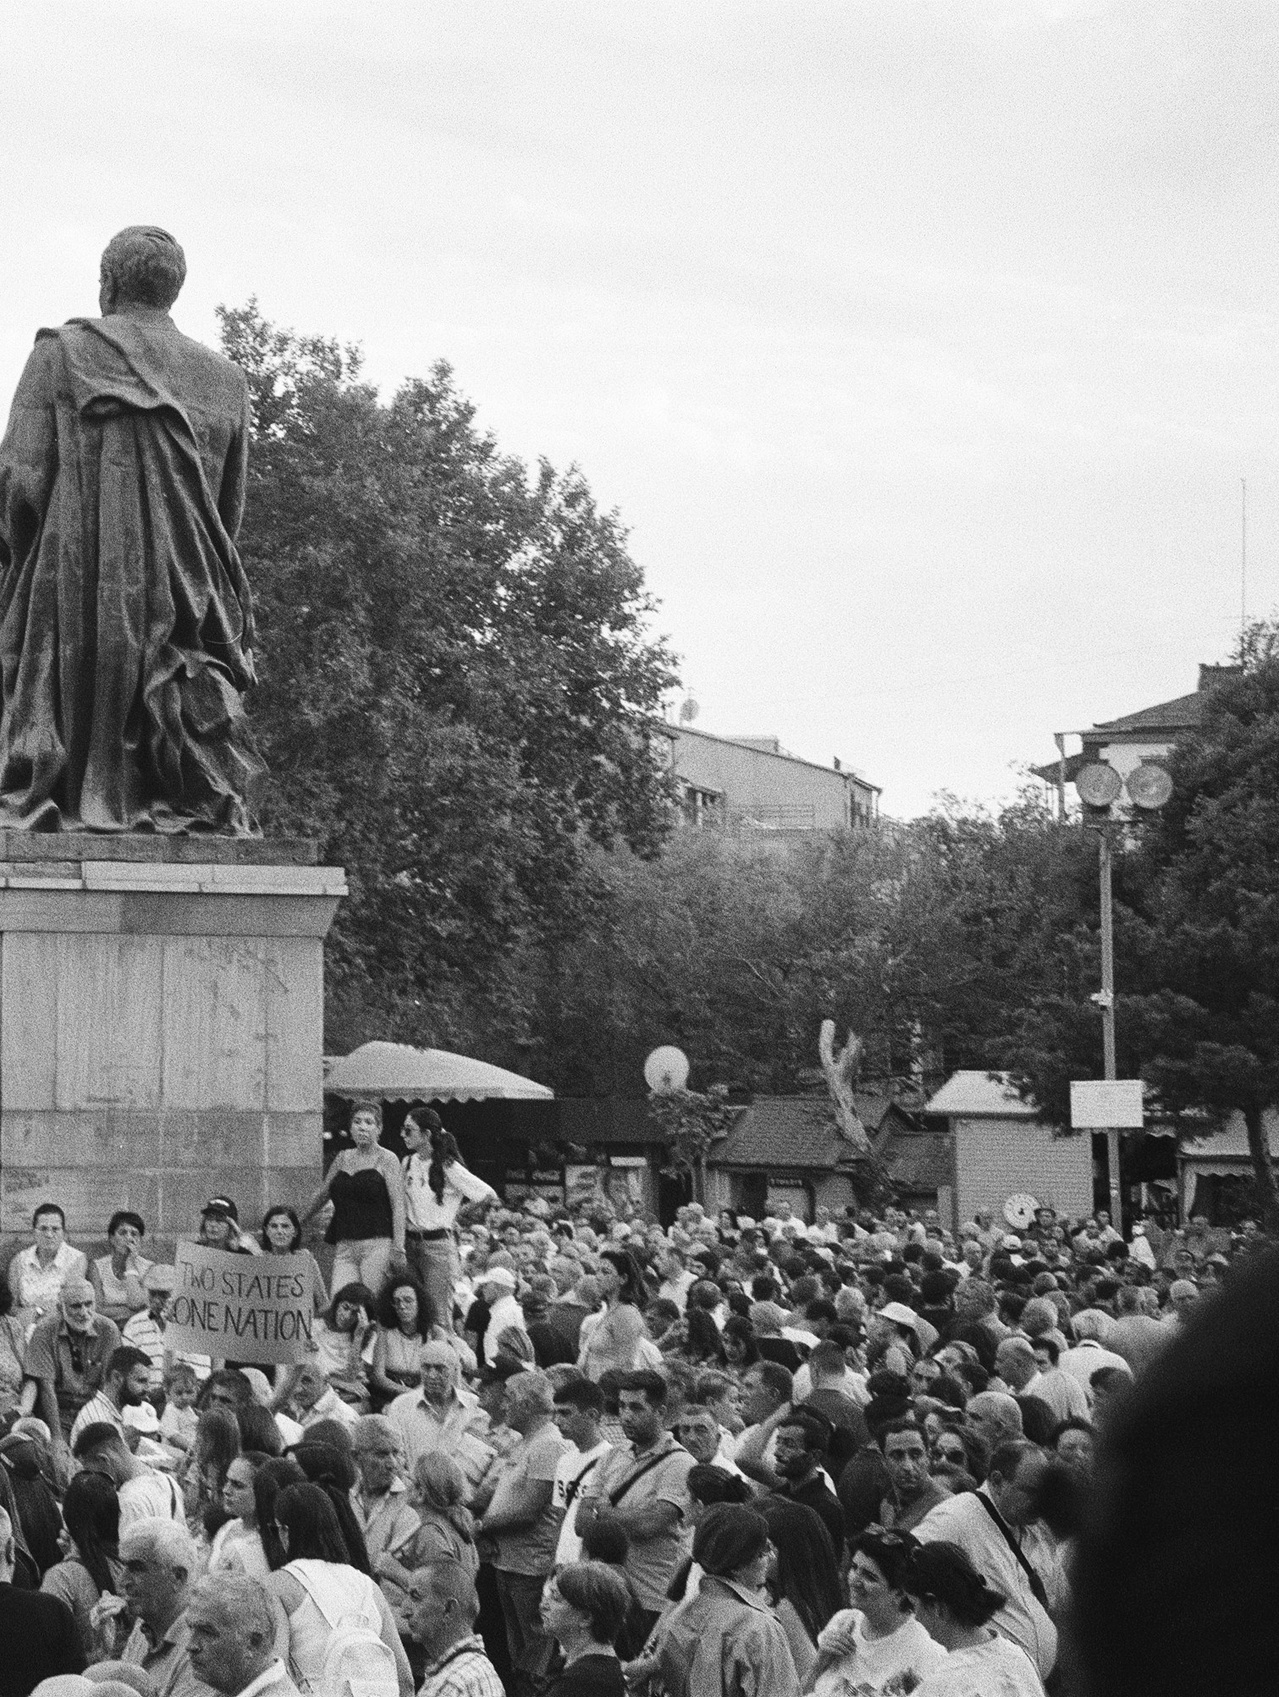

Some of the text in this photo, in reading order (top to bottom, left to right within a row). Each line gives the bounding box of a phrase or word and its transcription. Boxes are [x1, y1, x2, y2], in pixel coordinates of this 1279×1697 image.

[180, 1261, 305, 1300] TWO STATES
[173, 1295, 313, 1340] ONE NATION
